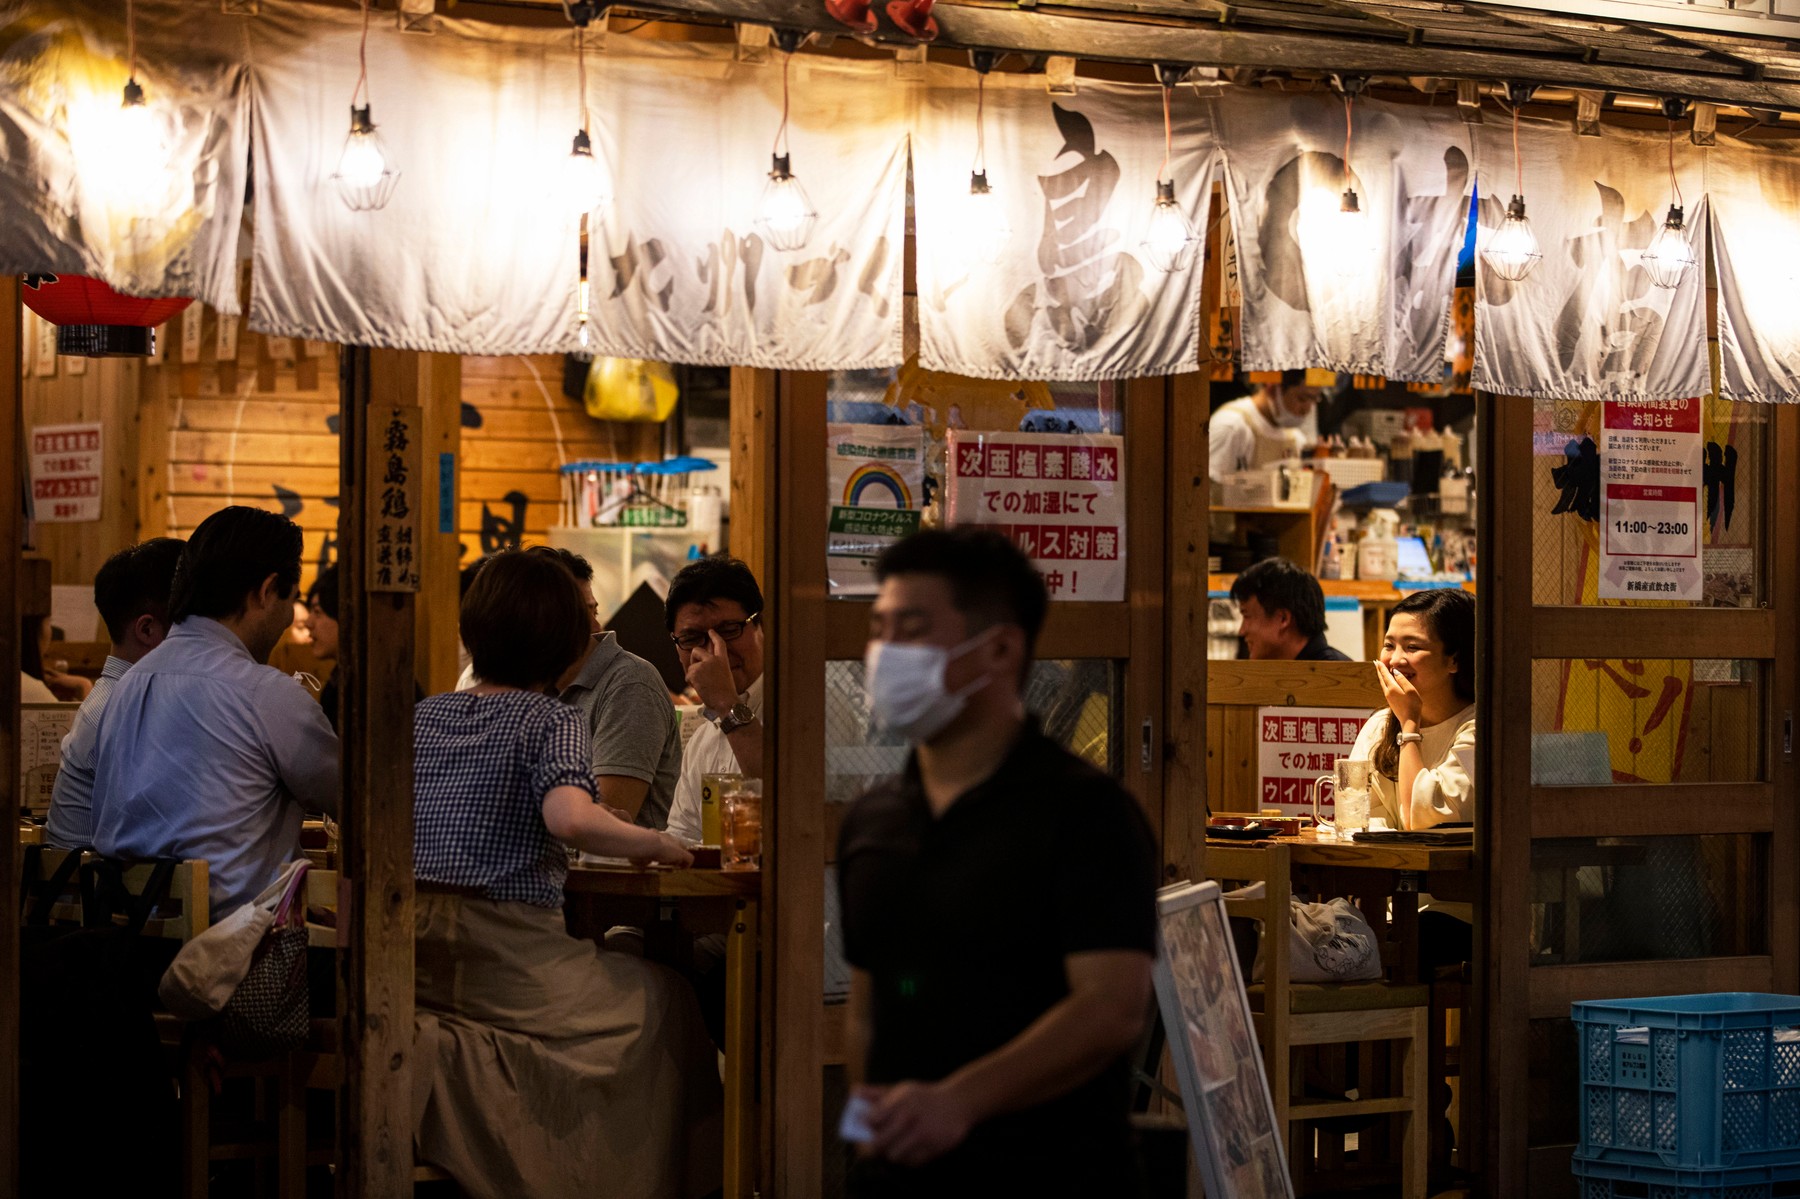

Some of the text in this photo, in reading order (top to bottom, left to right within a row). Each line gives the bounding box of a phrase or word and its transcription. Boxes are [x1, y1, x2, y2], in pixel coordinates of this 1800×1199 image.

[1632, 412, 1674, 428] お知らせ
[960, 448, 1115, 480] 次亜塩素酸水
[984, 490, 1098, 515] での加湿にて
[838, 509, 912, 523] 新型コロナウイルス
[1627, 581, 1677, 592] 新橋産直飲食街
[1265, 720, 1360, 743] 次亜塩素酸
